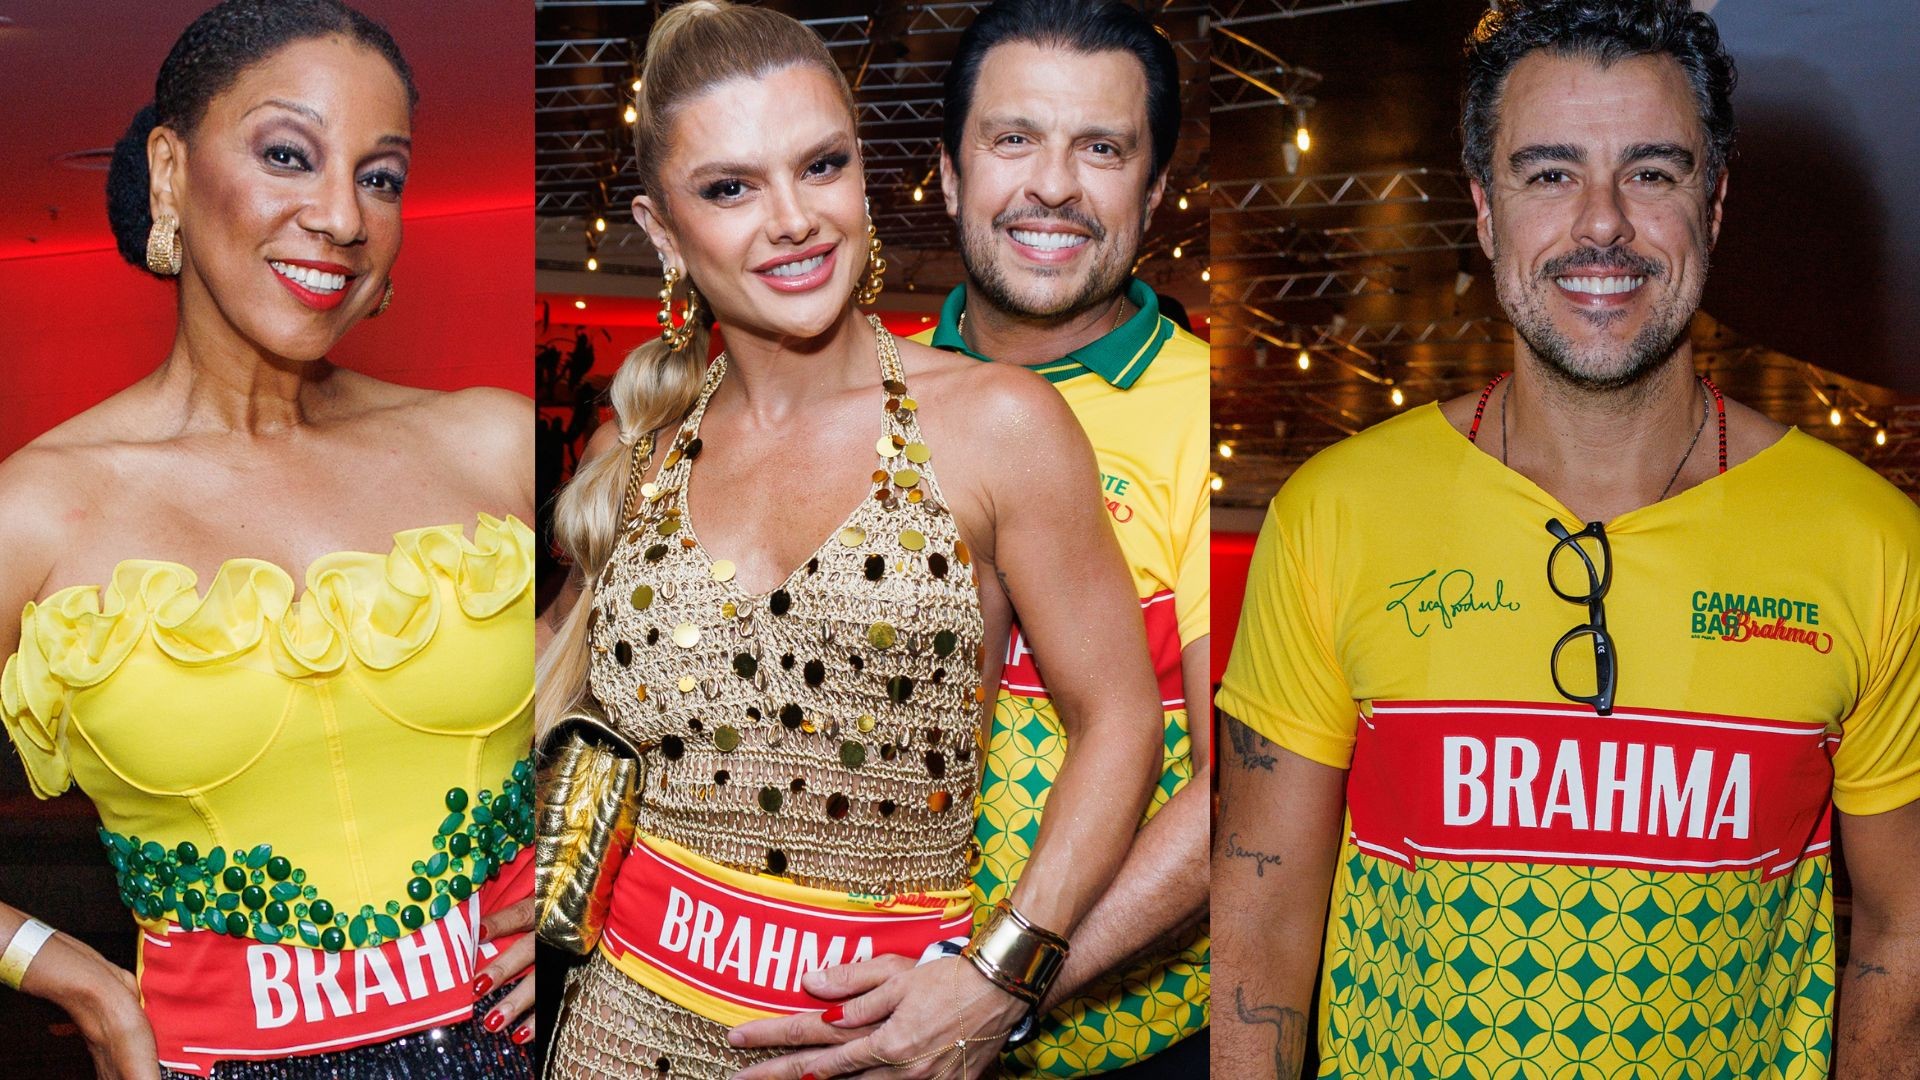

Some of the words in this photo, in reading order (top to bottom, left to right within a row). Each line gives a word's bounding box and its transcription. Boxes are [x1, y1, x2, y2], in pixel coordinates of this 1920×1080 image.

[1691, 612, 1740, 637] BAR
[1721, 608, 1833, 654] Brahma
[1692, 591, 1819, 625] CAMAROTE
[1443, 736, 1750, 840] BRAHMA
[1225, 832, 1282, 878] Sangue
[247, 892, 498, 1029] BRAHM
